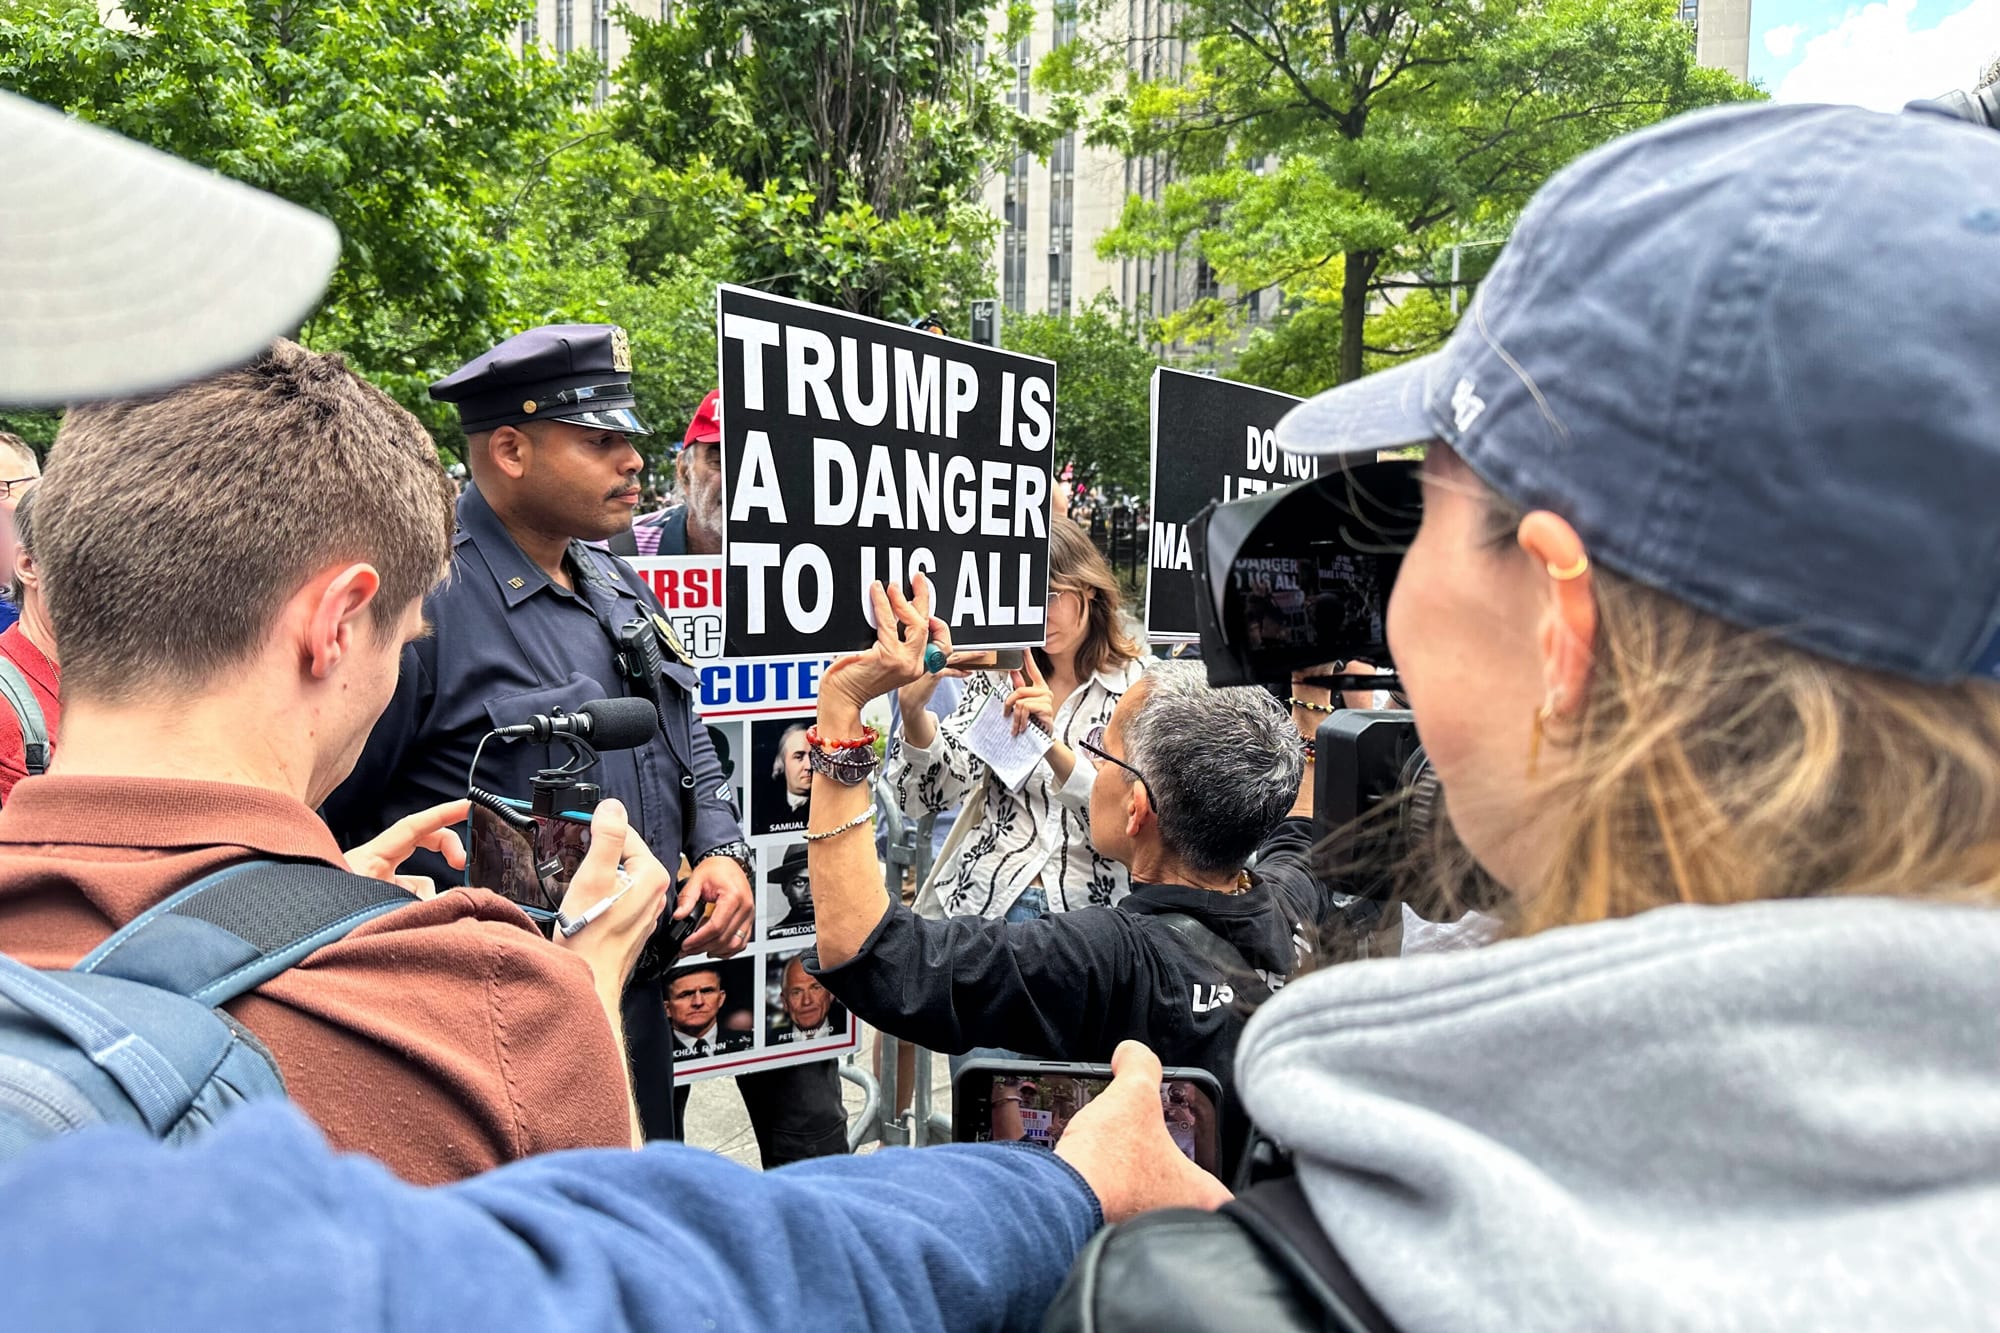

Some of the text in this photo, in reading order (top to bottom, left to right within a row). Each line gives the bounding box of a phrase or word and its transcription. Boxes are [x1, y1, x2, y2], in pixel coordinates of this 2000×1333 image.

[724, 312, 1051, 452] TRUMP IS
[1246, 425, 1278, 474] DO
[730, 430, 1047, 539] A DANGER
[638, 568, 722, 609] RS
[729, 542, 1044, 634] TO US ALL
[700, 660, 831, 706] CUTE
[769, 821, 805, 833] SAMUAL
